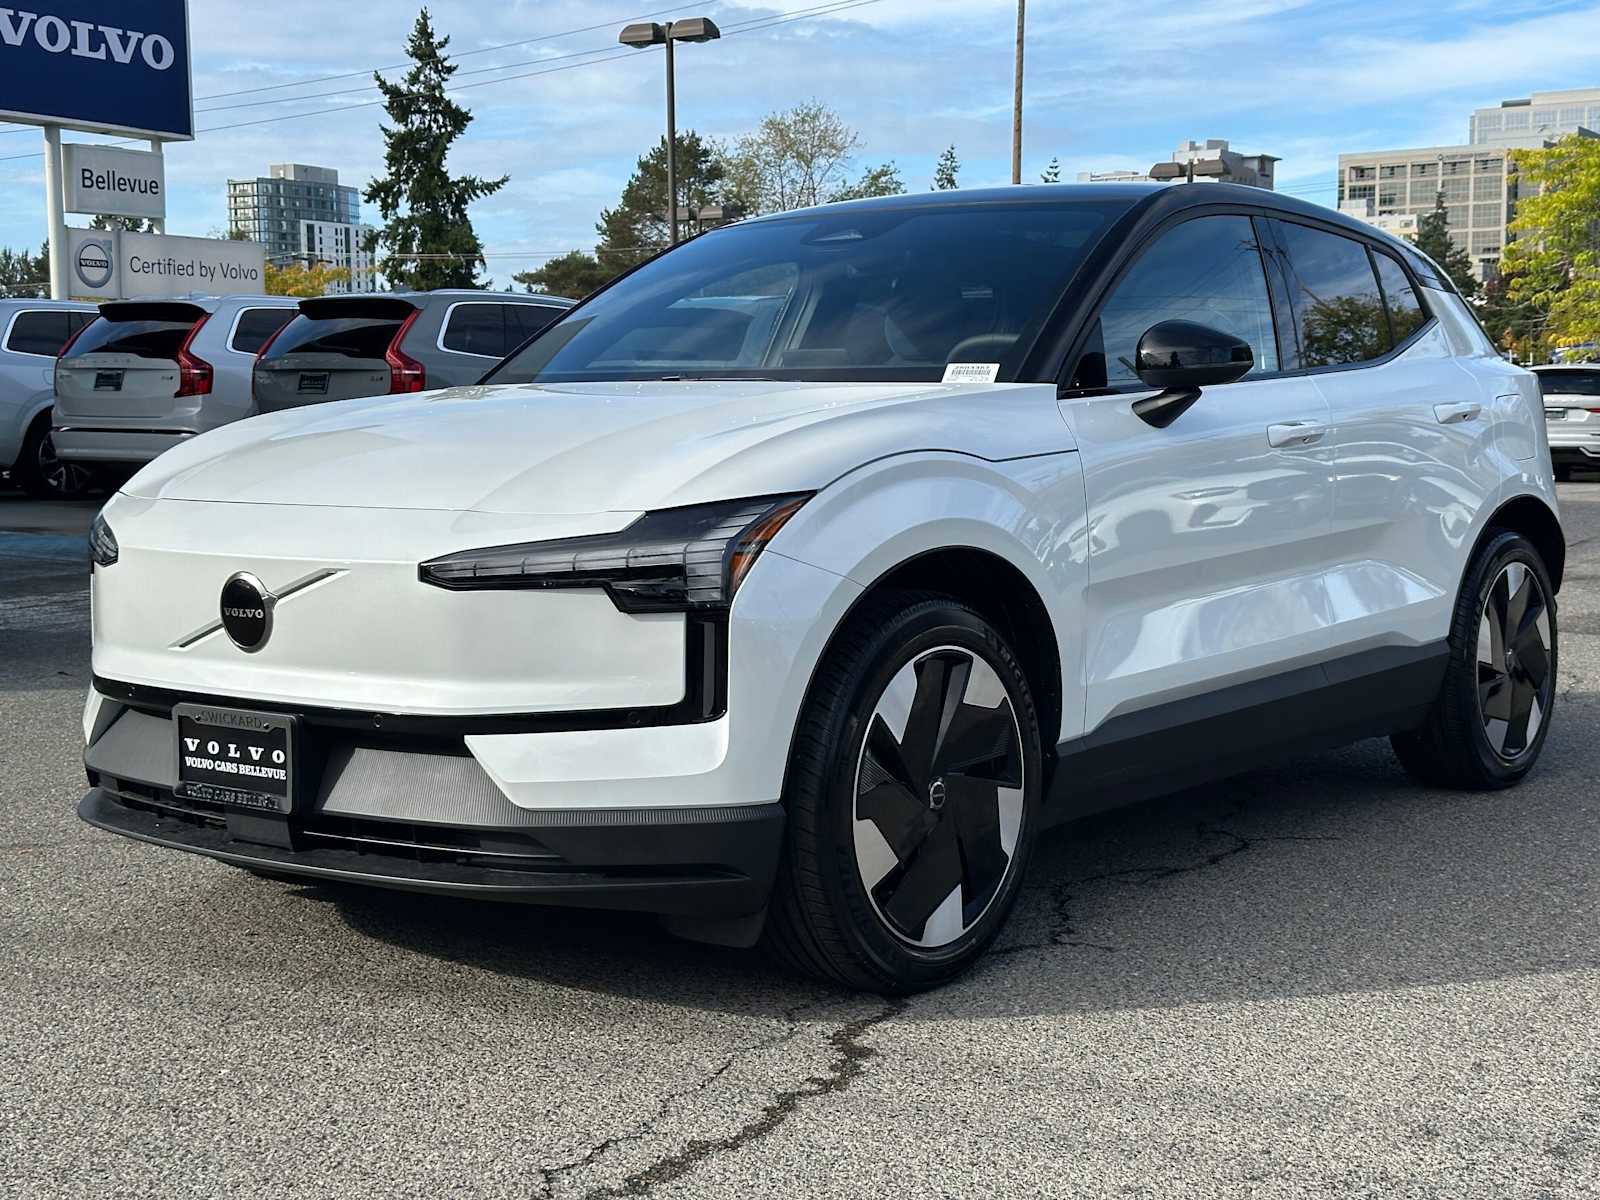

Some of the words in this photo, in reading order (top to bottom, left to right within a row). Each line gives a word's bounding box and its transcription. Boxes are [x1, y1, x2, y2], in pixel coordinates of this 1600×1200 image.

[0, 8, 175, 70] VOLVO
[81, 168, 159, 195] Bellevue
[129, 256, 194, 277] Certified
[199, 260, 216, 282] by
[219, 262, 258, 280] Volvo
[224, 607, 264, 619] VOLVO
[201, 711, 262, 729] SWICKARD
[184, 737, 286, 764] VOLVO
[185, 756, 214, 770] VOLVO
[214, 760, 238, 774] CARS
[238, 763, 287, 781] BELLEVUE
